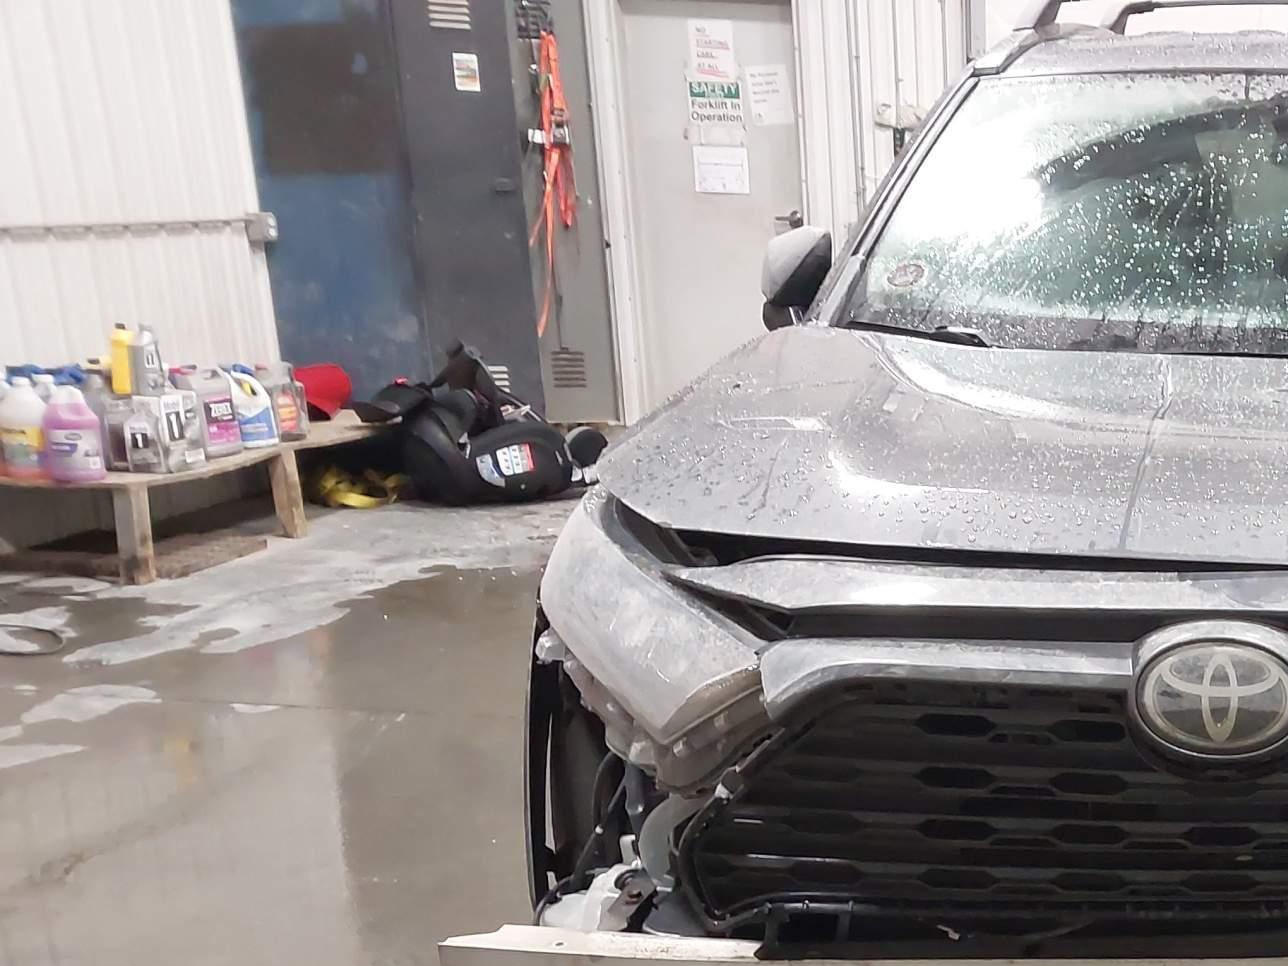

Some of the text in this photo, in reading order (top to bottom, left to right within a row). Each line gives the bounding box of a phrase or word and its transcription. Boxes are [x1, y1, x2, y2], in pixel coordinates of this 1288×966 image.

[691, 82, 738, 95] SAFETY
[691, 100, 728, 110] Forklift
[691, 111, 742, 122] Operation
